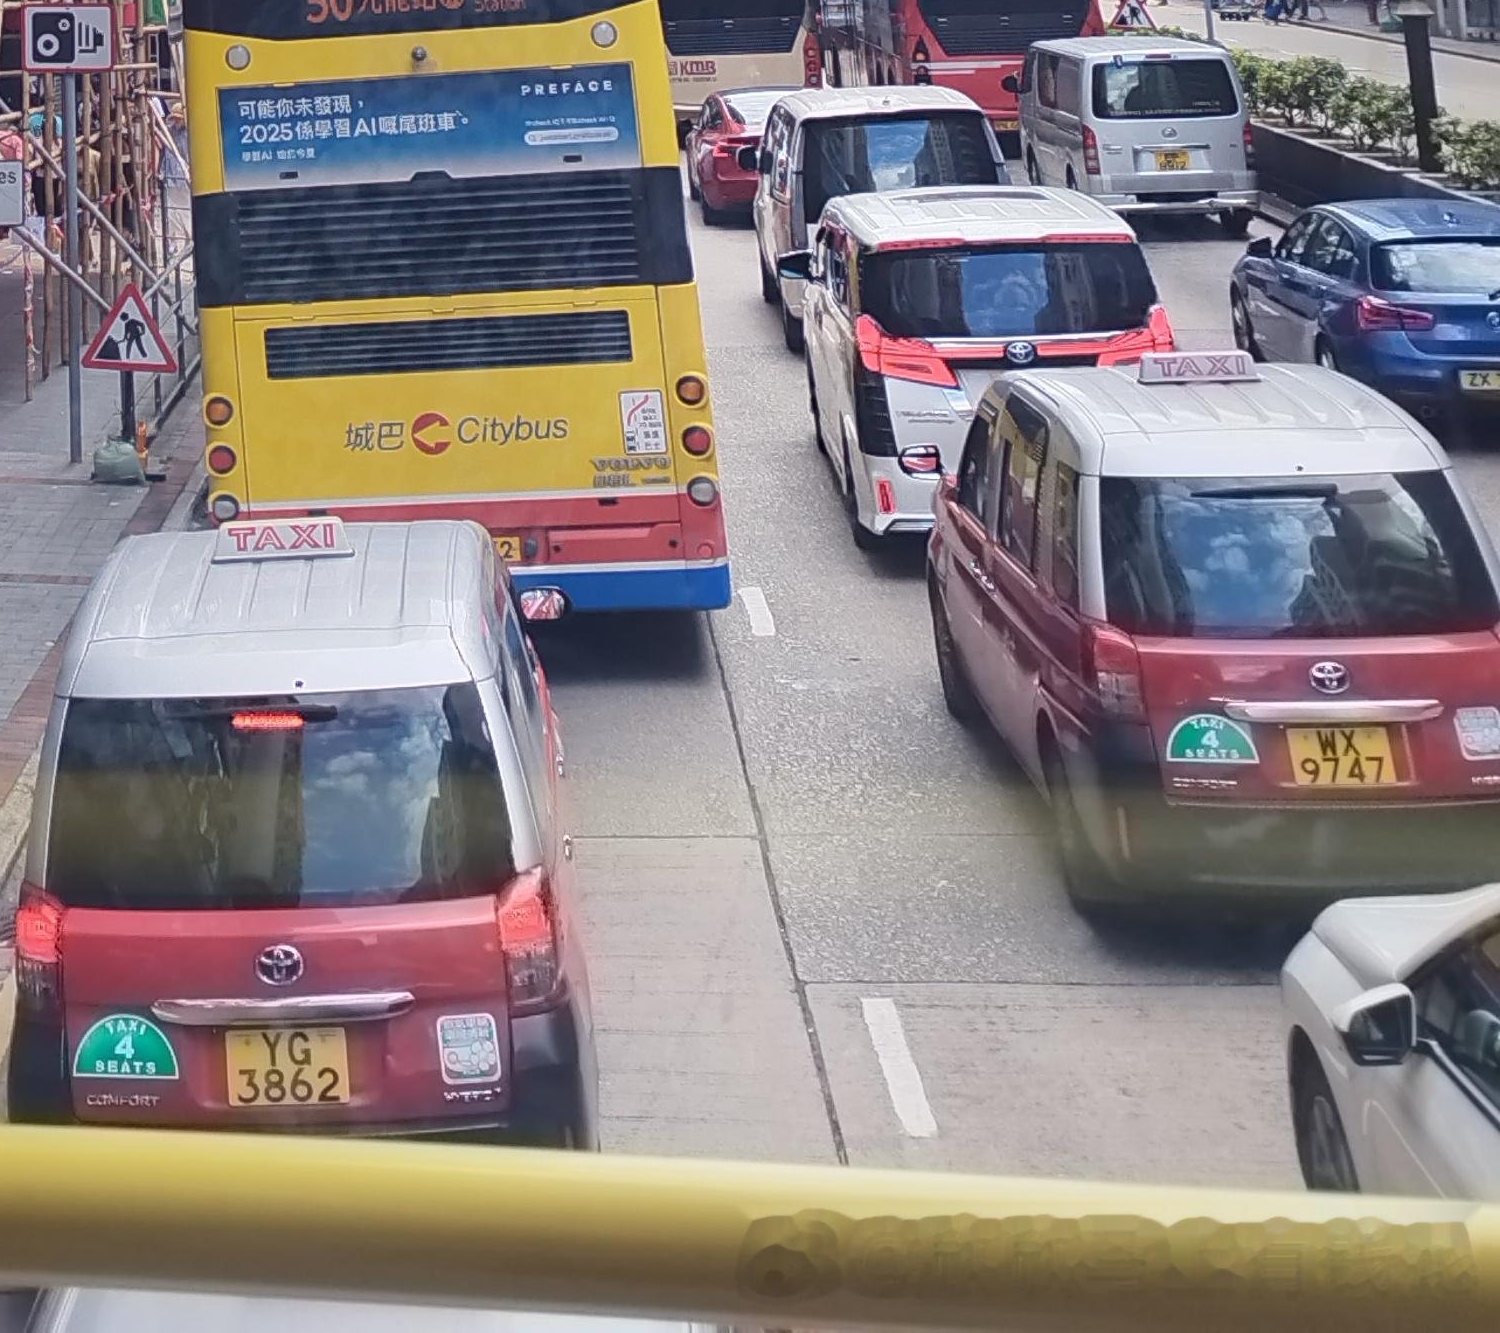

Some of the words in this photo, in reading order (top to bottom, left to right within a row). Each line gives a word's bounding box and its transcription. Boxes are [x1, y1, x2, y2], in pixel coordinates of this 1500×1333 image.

[680, 60, 717, 77] KMB
[1153, 356, 1246, 377] TAXI
[1468, 372, 1492, 387] ZX
[344, 421, 406, 453] 城巴
[457, 414, 569, 446] Citybus
[590, 456, 672, 471] VOLVO
[228, 523, 337, 552] TAXI
[1201, 730, 1219, 748] 4
[1316, 729, 1361, 757] WX
[1185, 748, 1240, 759] SEATS
[1301, 756, 1385, 784] 9747
[104, 1020, 148, 1036] TAXI
[114, 1034, 135, 1060] 4
[261, 1031, 312, 1068] YG
[94, 1060, 157, 1075] SEATS
[236, 1067, 341, 1104] 3862
[86, 1094, 161, 1108] COMFORT
